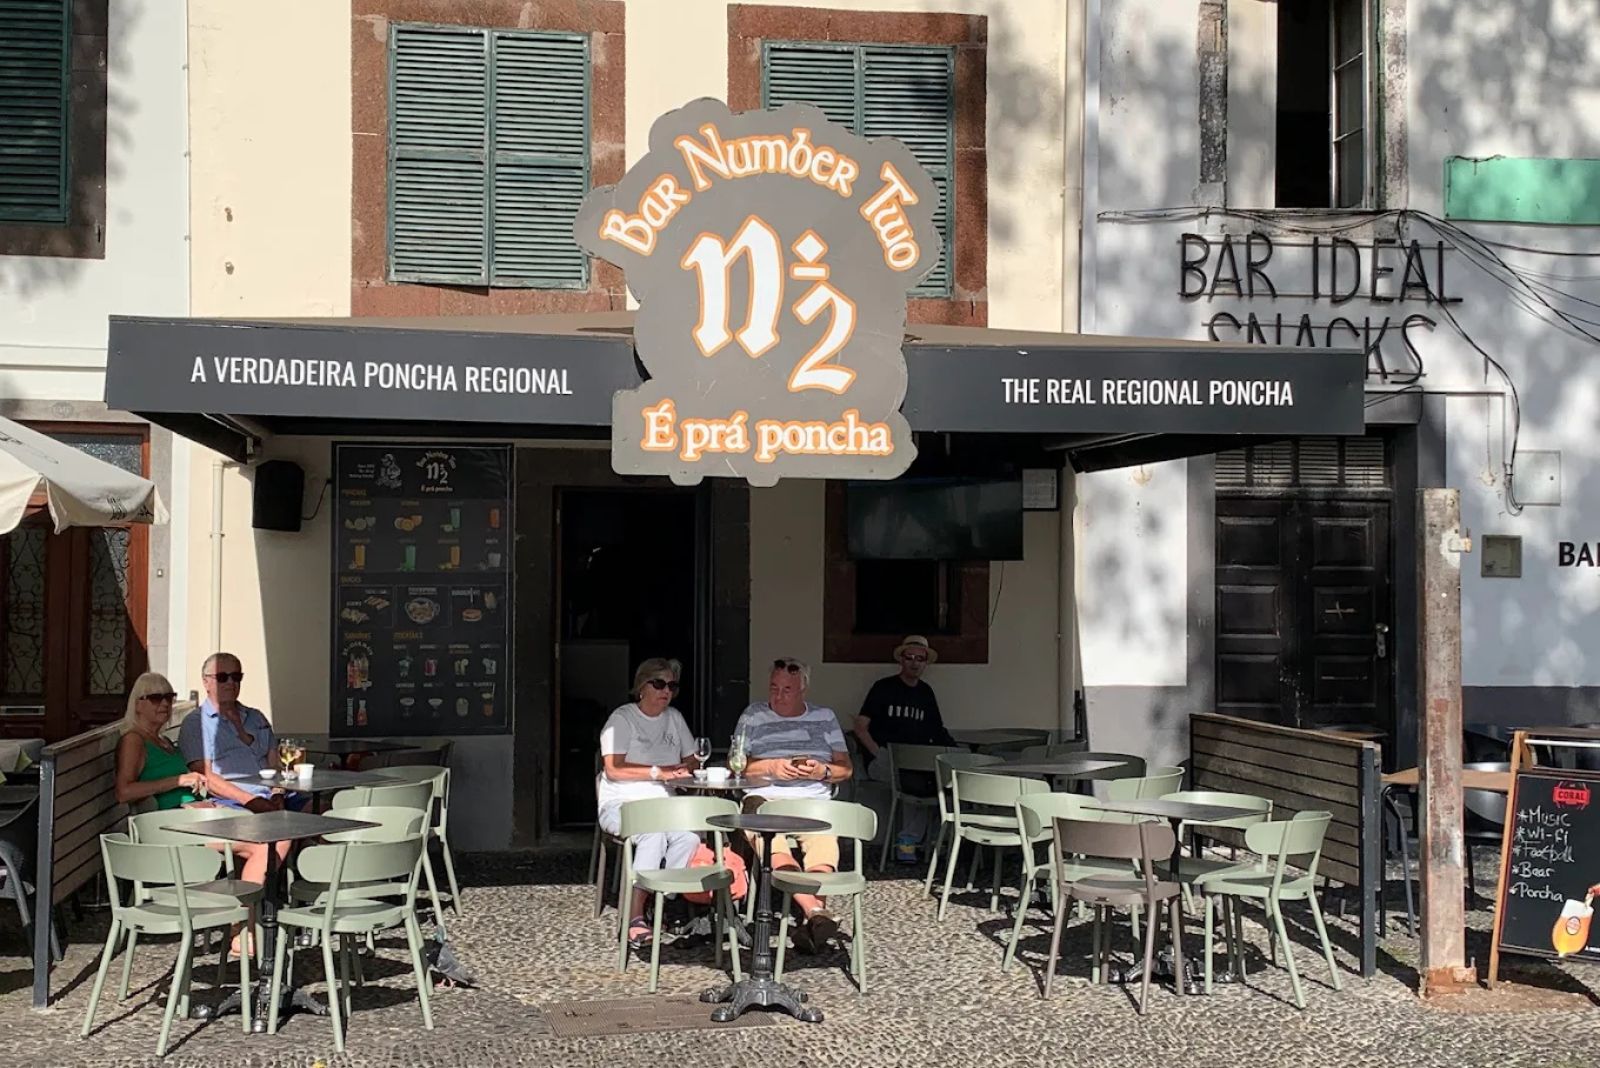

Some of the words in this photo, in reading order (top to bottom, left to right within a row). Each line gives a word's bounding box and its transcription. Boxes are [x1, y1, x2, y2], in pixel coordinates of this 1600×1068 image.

[1179, 233, 1277, 300] BAR
[1312, 235, 1463, 303] IDEAL
[191, 356, 206, 383] A
[214, 357, 356, 387] VERDADEIRA
[364, 362, 457, 391] PONCHA
[465, 366, 573, 395] REGIONAL
[1001, 378, 1040, 403] THE
[1046, 379, 1096, 404] REAL
[1102, 379, 1203, 405] REGIONAL
[1209, 380, 1294, 406] PONCHA
[642, 400, 676, 451] É
[681, 411, 749, 461] prá
[755, 410, 894, 462] poncha
[1559, 541, 1600, 567] BA
[1558, 790, 1585, 801] CORAL
